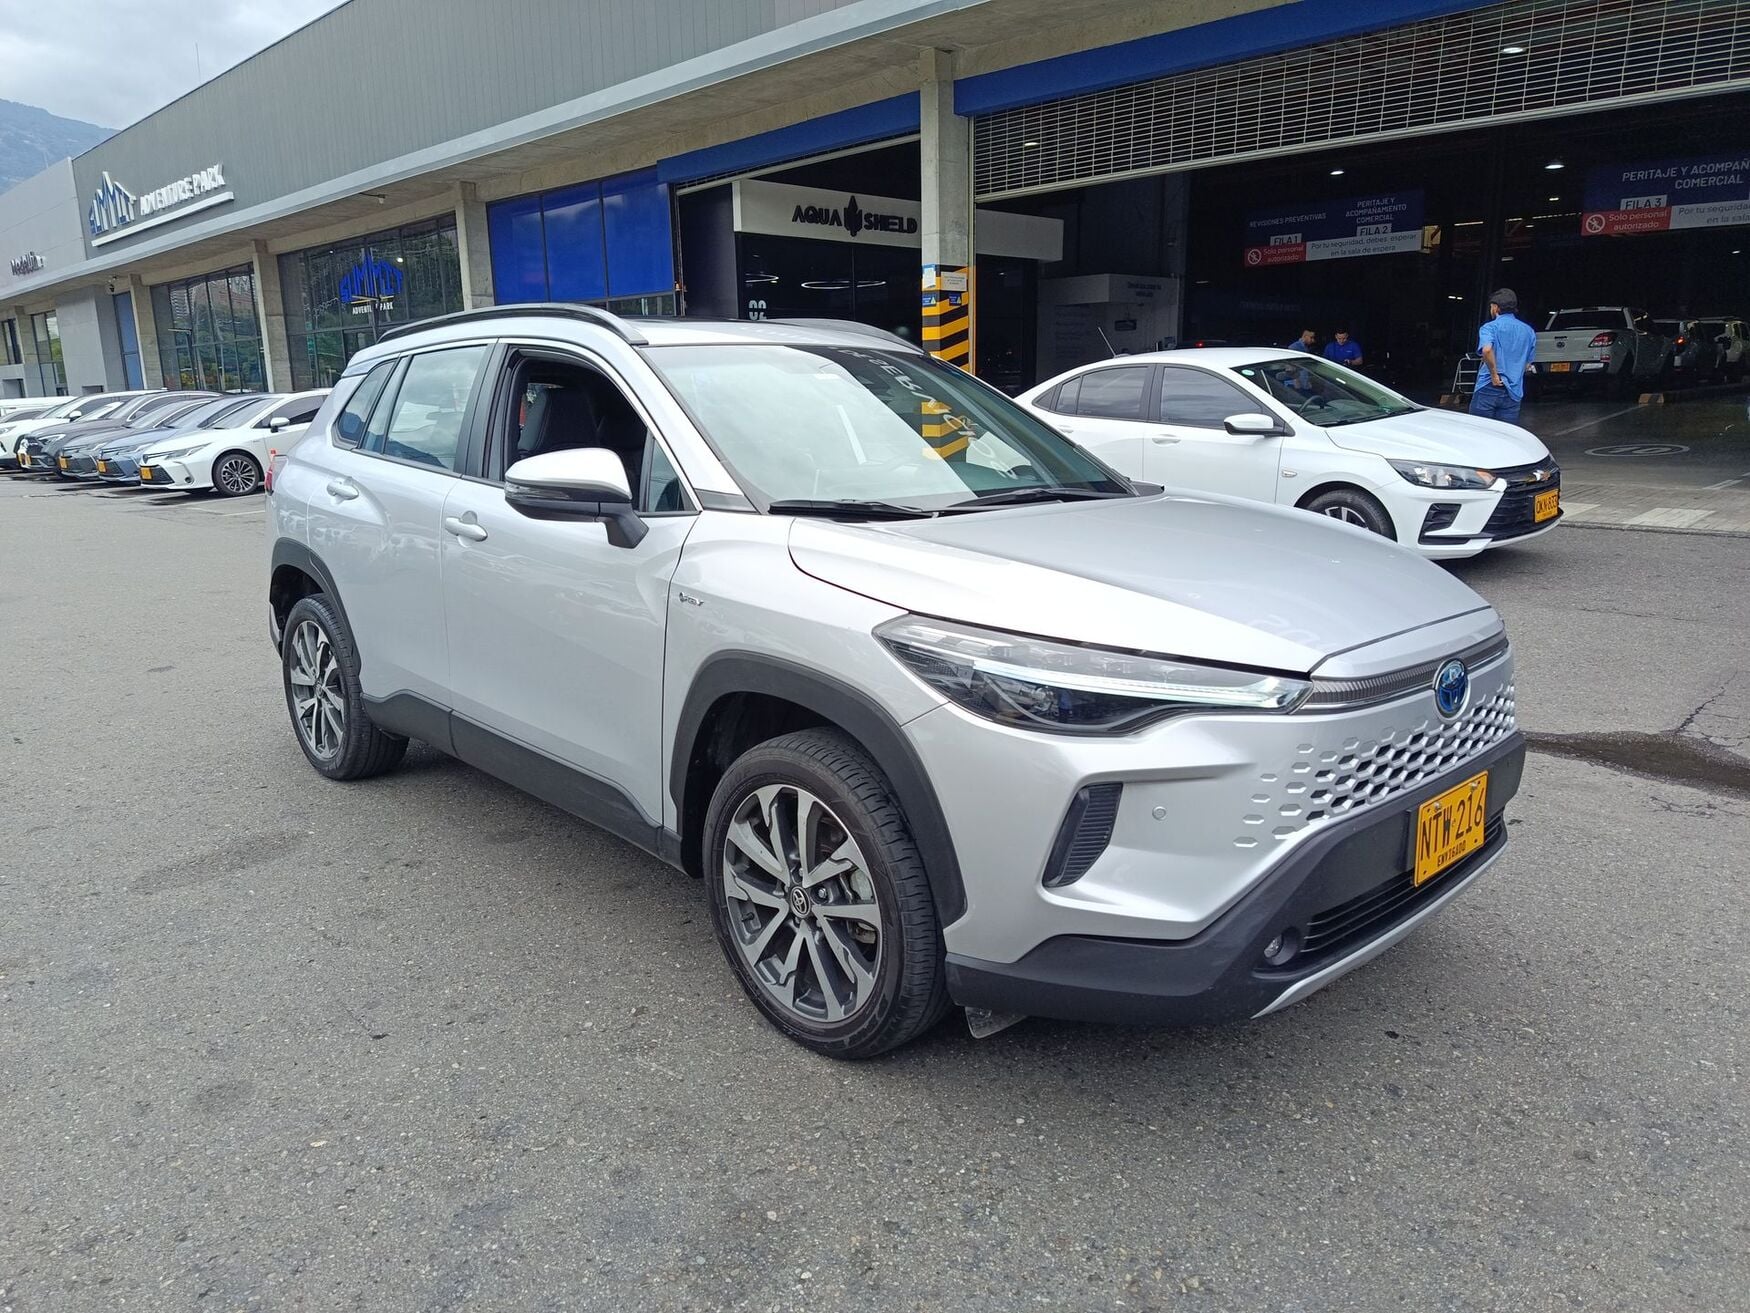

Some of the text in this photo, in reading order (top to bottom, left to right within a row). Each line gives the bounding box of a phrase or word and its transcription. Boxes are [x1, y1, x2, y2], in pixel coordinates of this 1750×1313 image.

[1622, 167, 1678, 182] PERITAJE
[1681, 166, 1689, 176] Y
[1675, 174, 1744, 190] COMERCIAL
[140, 164, 226, 216] ADVENTURE PARK
[1357, 197, 1389, 208] PERITAJE
[1625, 198, 1662, 210] FILA 3
[1608, 210, 1667, 222] Solo personal
[1679, 207, 1694, 215] Por
[1696, 206, 1705, 214] tu
[792, 205, 918, 234] AQUA SHIELD
[1285, 212, 1326, 224] PREVENTIVAS
[1356, 214, 1394, 223] COMERCIAL
[1360, 226, 1389, 236] FILA 2
[1614, 221, 1659, 231] autorizado
[1274, 236, 1293, 246] FILA
[379, 302, 393, 311] PARK
